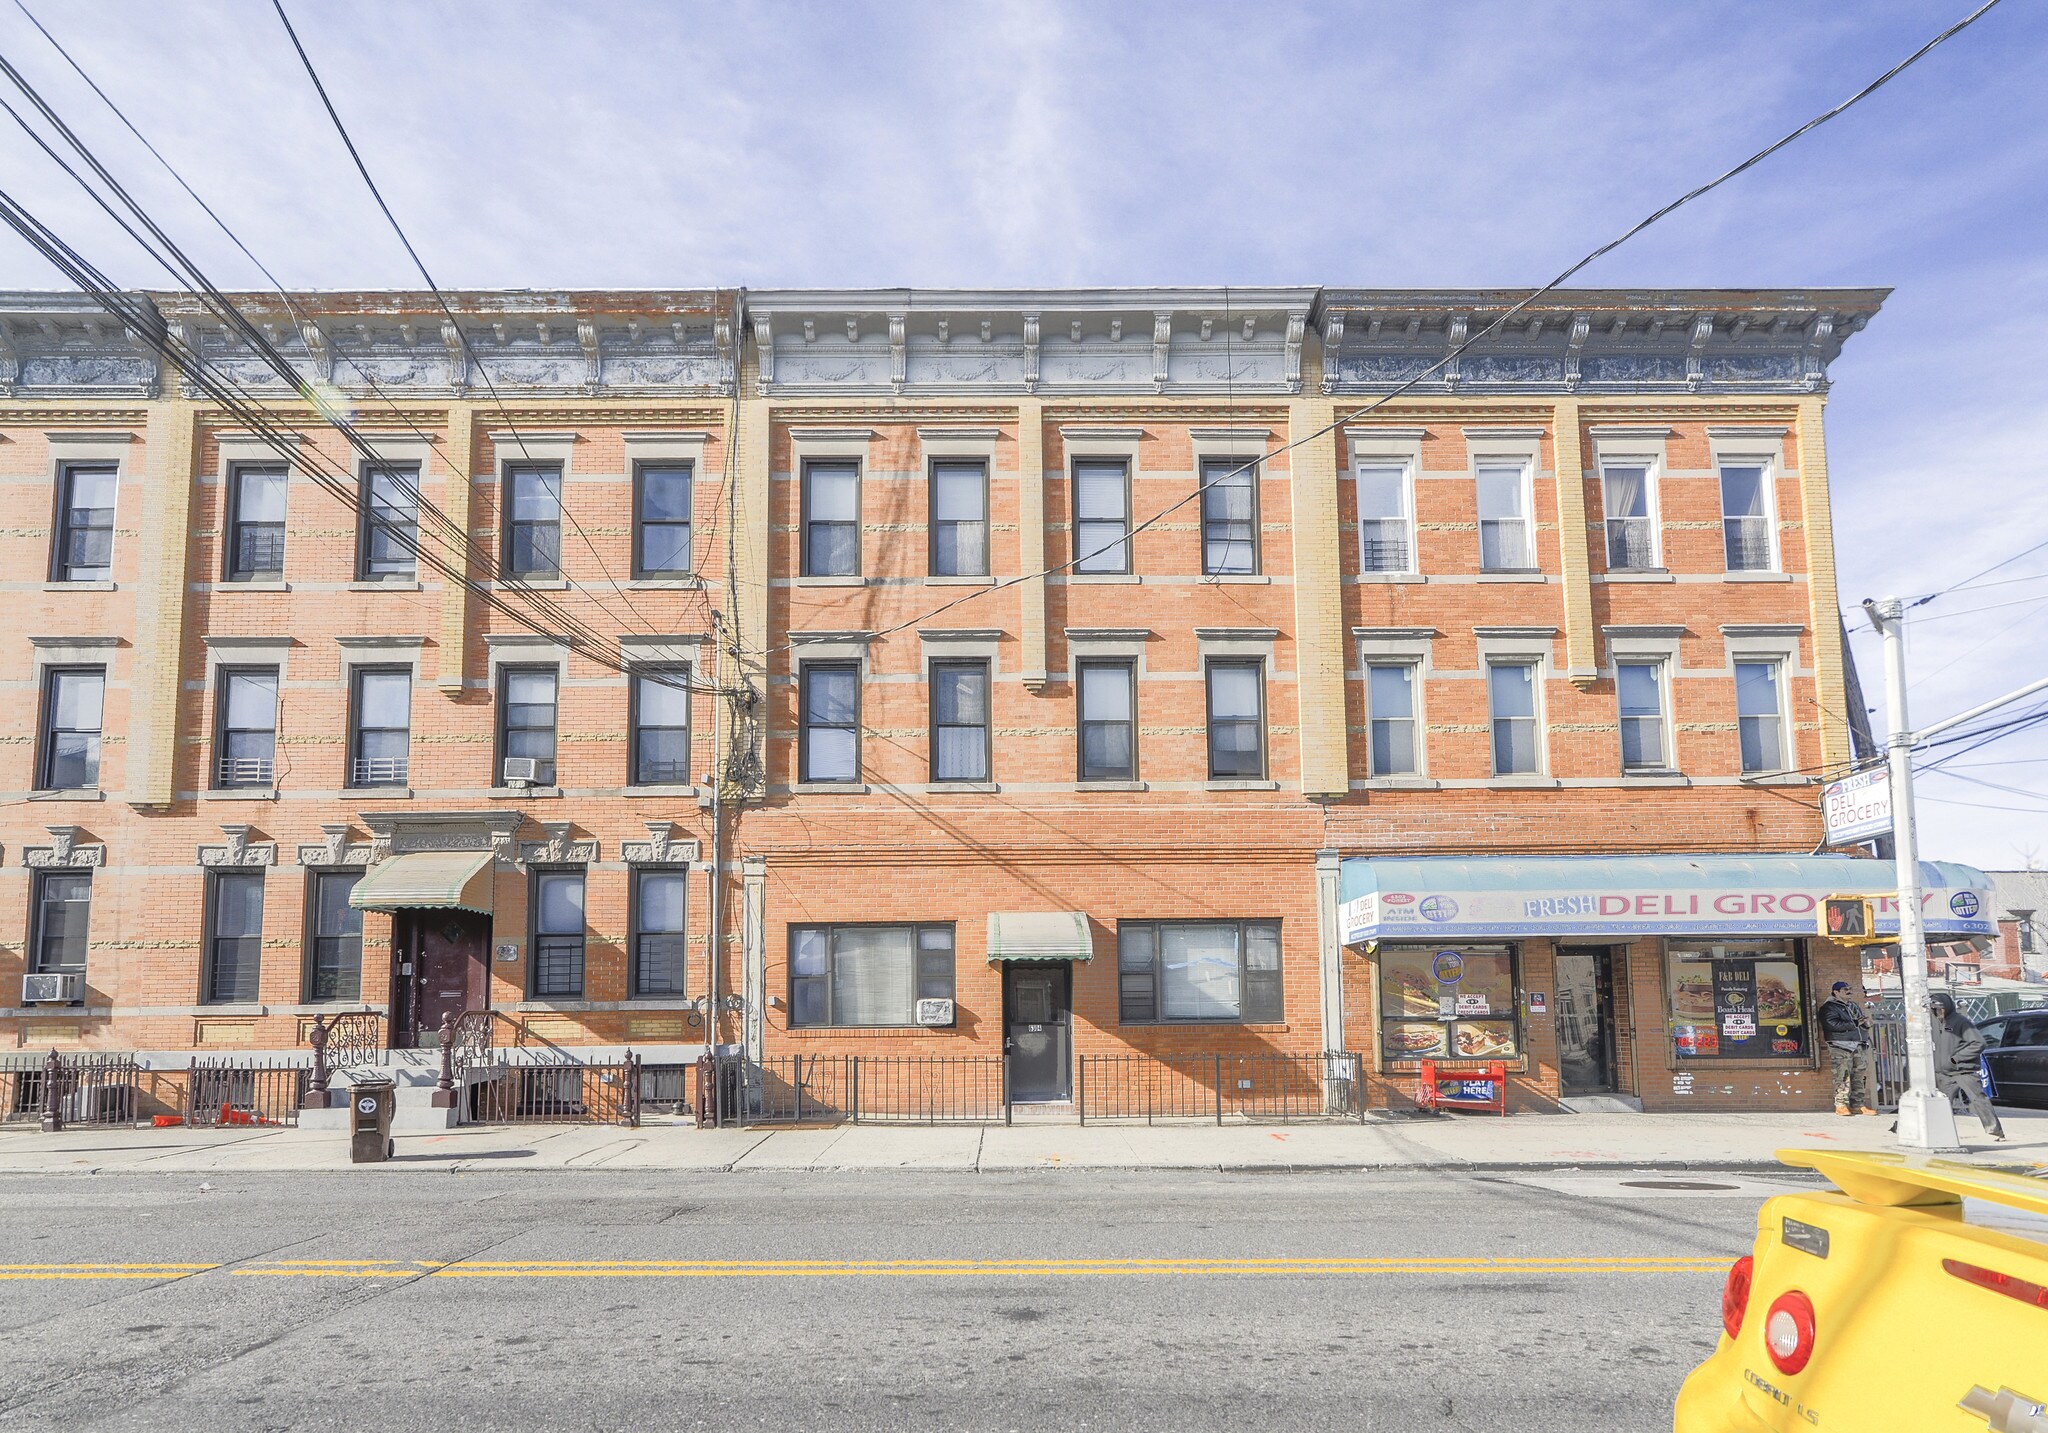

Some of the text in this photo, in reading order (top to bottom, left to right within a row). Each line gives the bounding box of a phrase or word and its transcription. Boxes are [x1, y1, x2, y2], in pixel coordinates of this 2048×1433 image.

[1831, 793, 1856, 812] DELI
[1829, 800, 1888, 828] GROCERY
[1360, 898, 1373, 911] DELI
[1525, 896, 1595, 917] FRESH
[1600, 895, 1697, 915] DELI
[1347, 911, 1374, 929] GROCERY
[1963, 922, 1989, 930] 6302
[1735, 972, 1750, 981] DELI
[1737, 1005, 1755, 1013] Head
[1772, 1040, 1798, 1052] OPEN
[1744, 1368, 1820, 1427] COBALT LS
